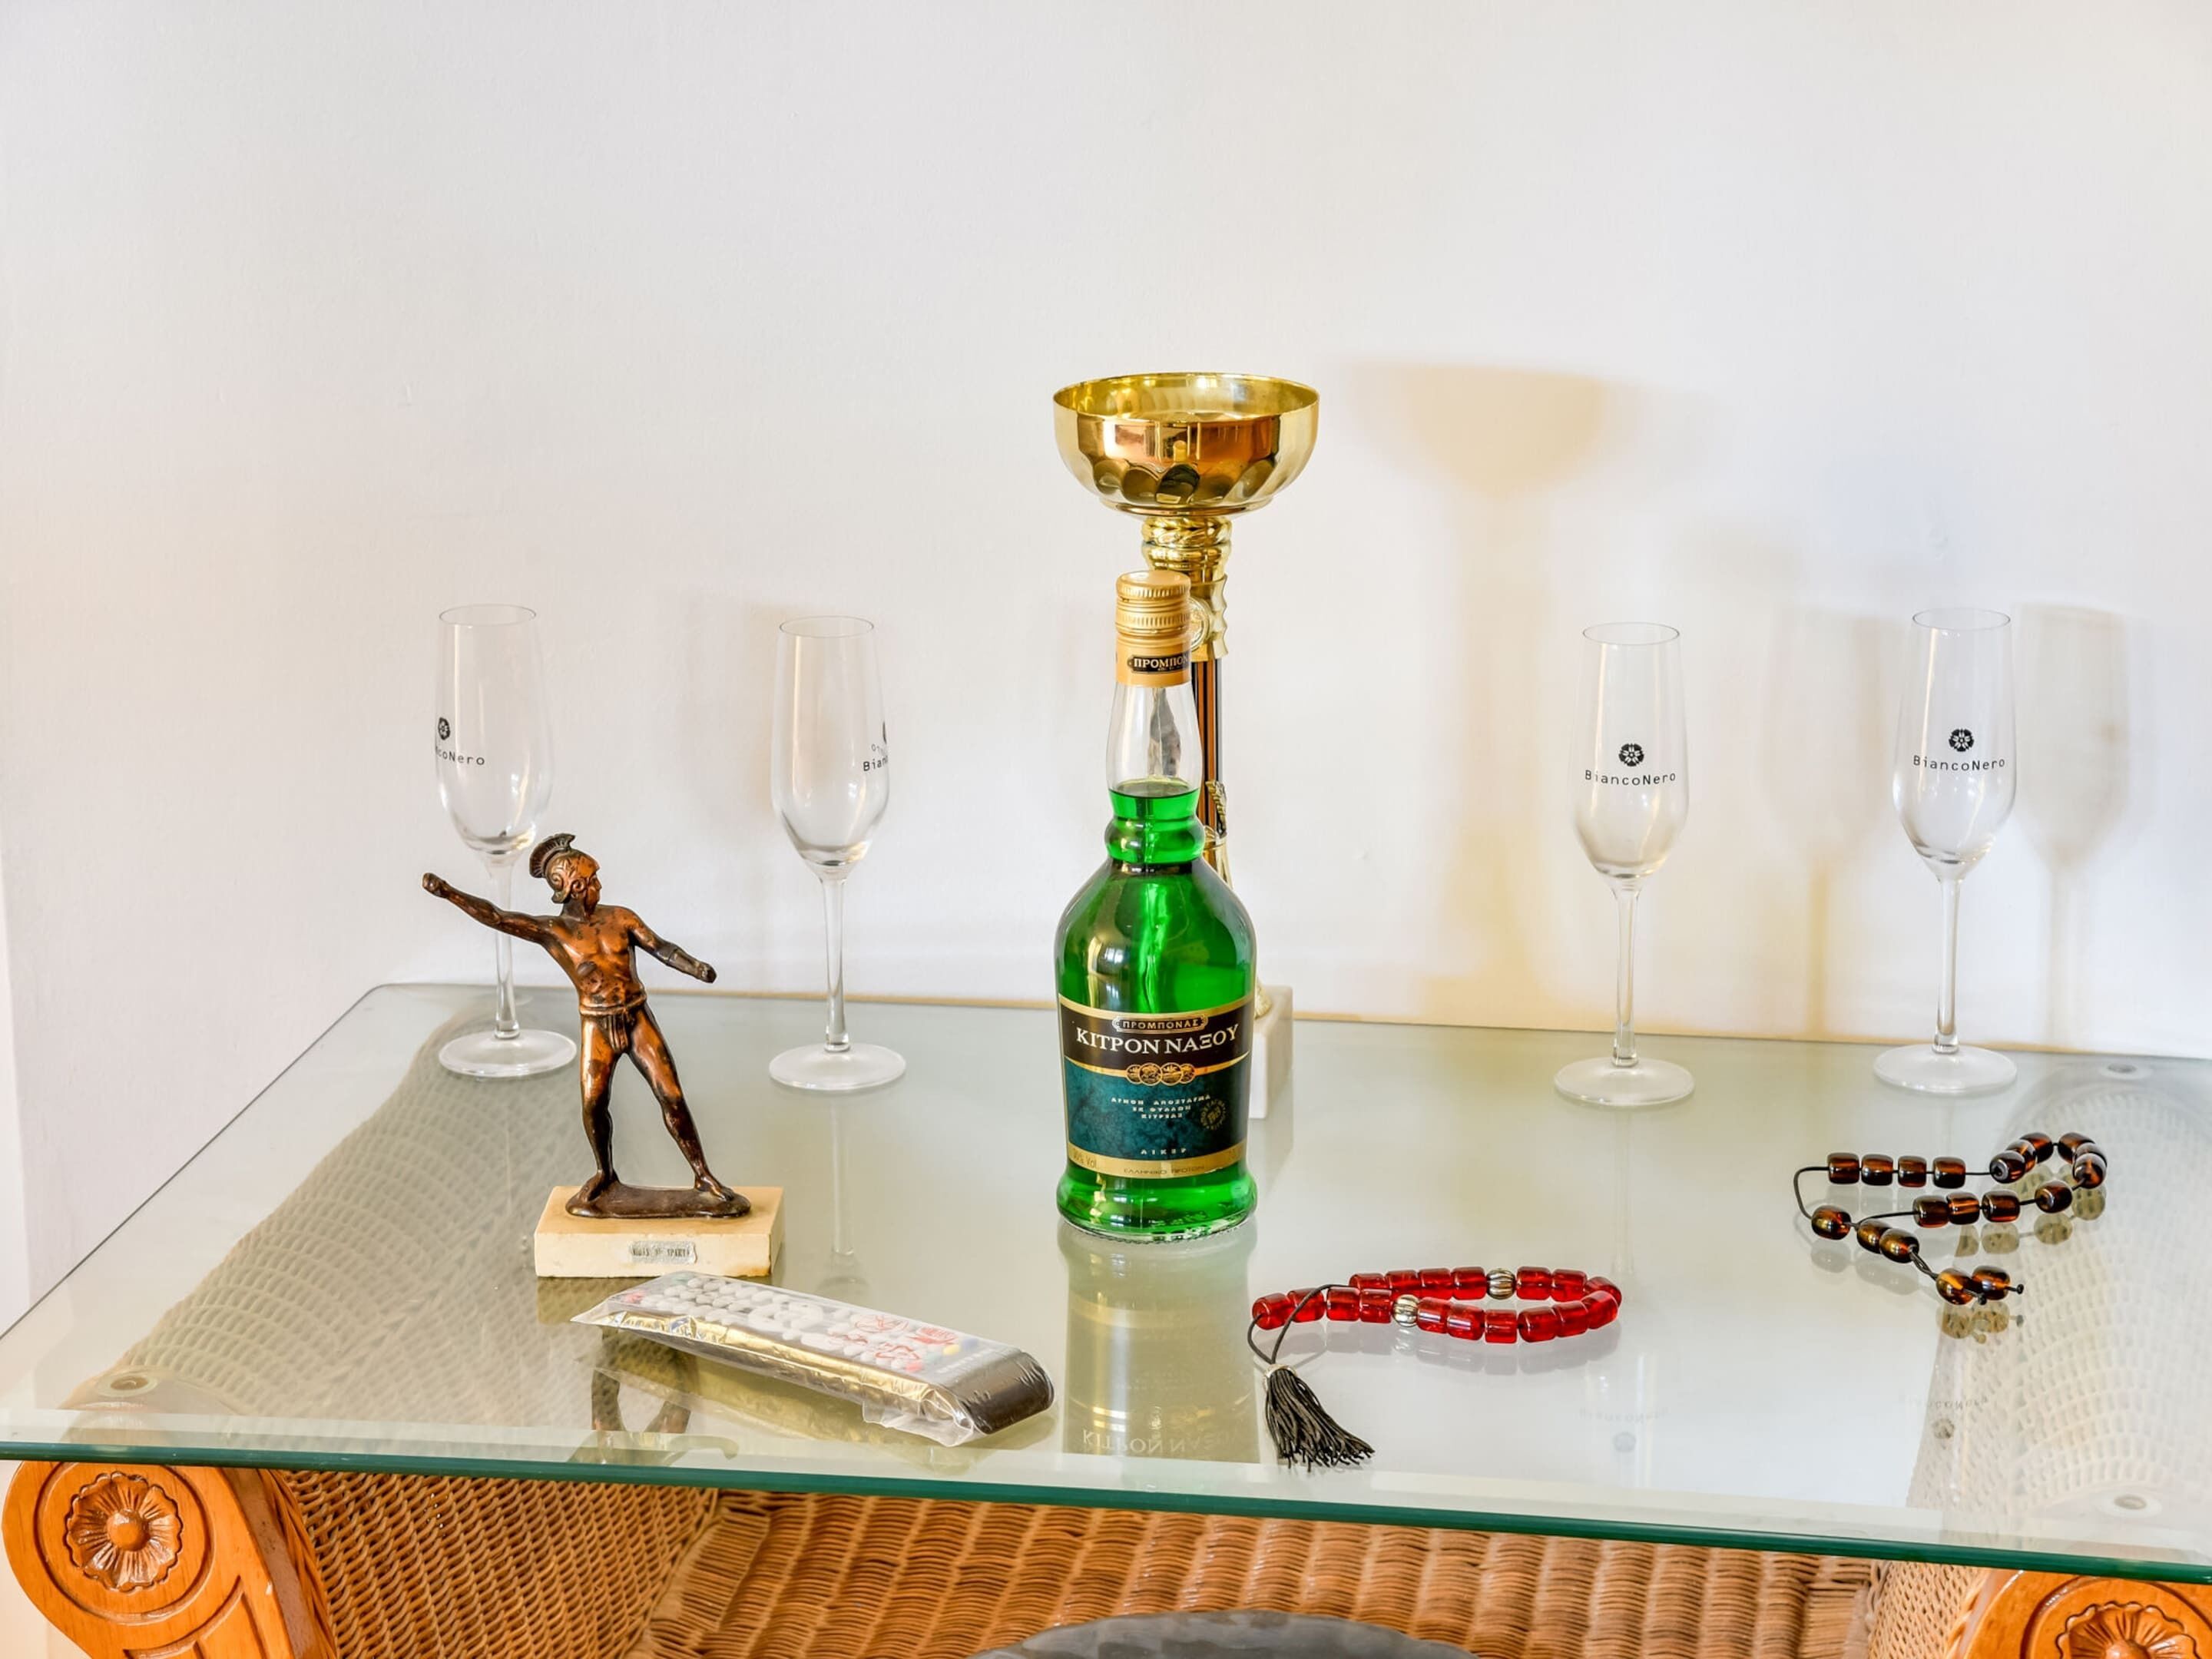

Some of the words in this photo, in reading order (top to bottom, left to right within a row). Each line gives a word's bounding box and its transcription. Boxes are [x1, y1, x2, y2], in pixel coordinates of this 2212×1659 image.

[1913, 755, 2005, 771] BiancoNero
[1584, 769, 1675, 786] BiancoNero
[1123, 1019, 1199, 1030] ΠΡΟΜΠΟΝΑΣ
[1075, 1027, 1160, 1055] ΚΙΤΡΟΝ
[1164, 1024, 1239, 1055] ΝΑΞΟΥ
